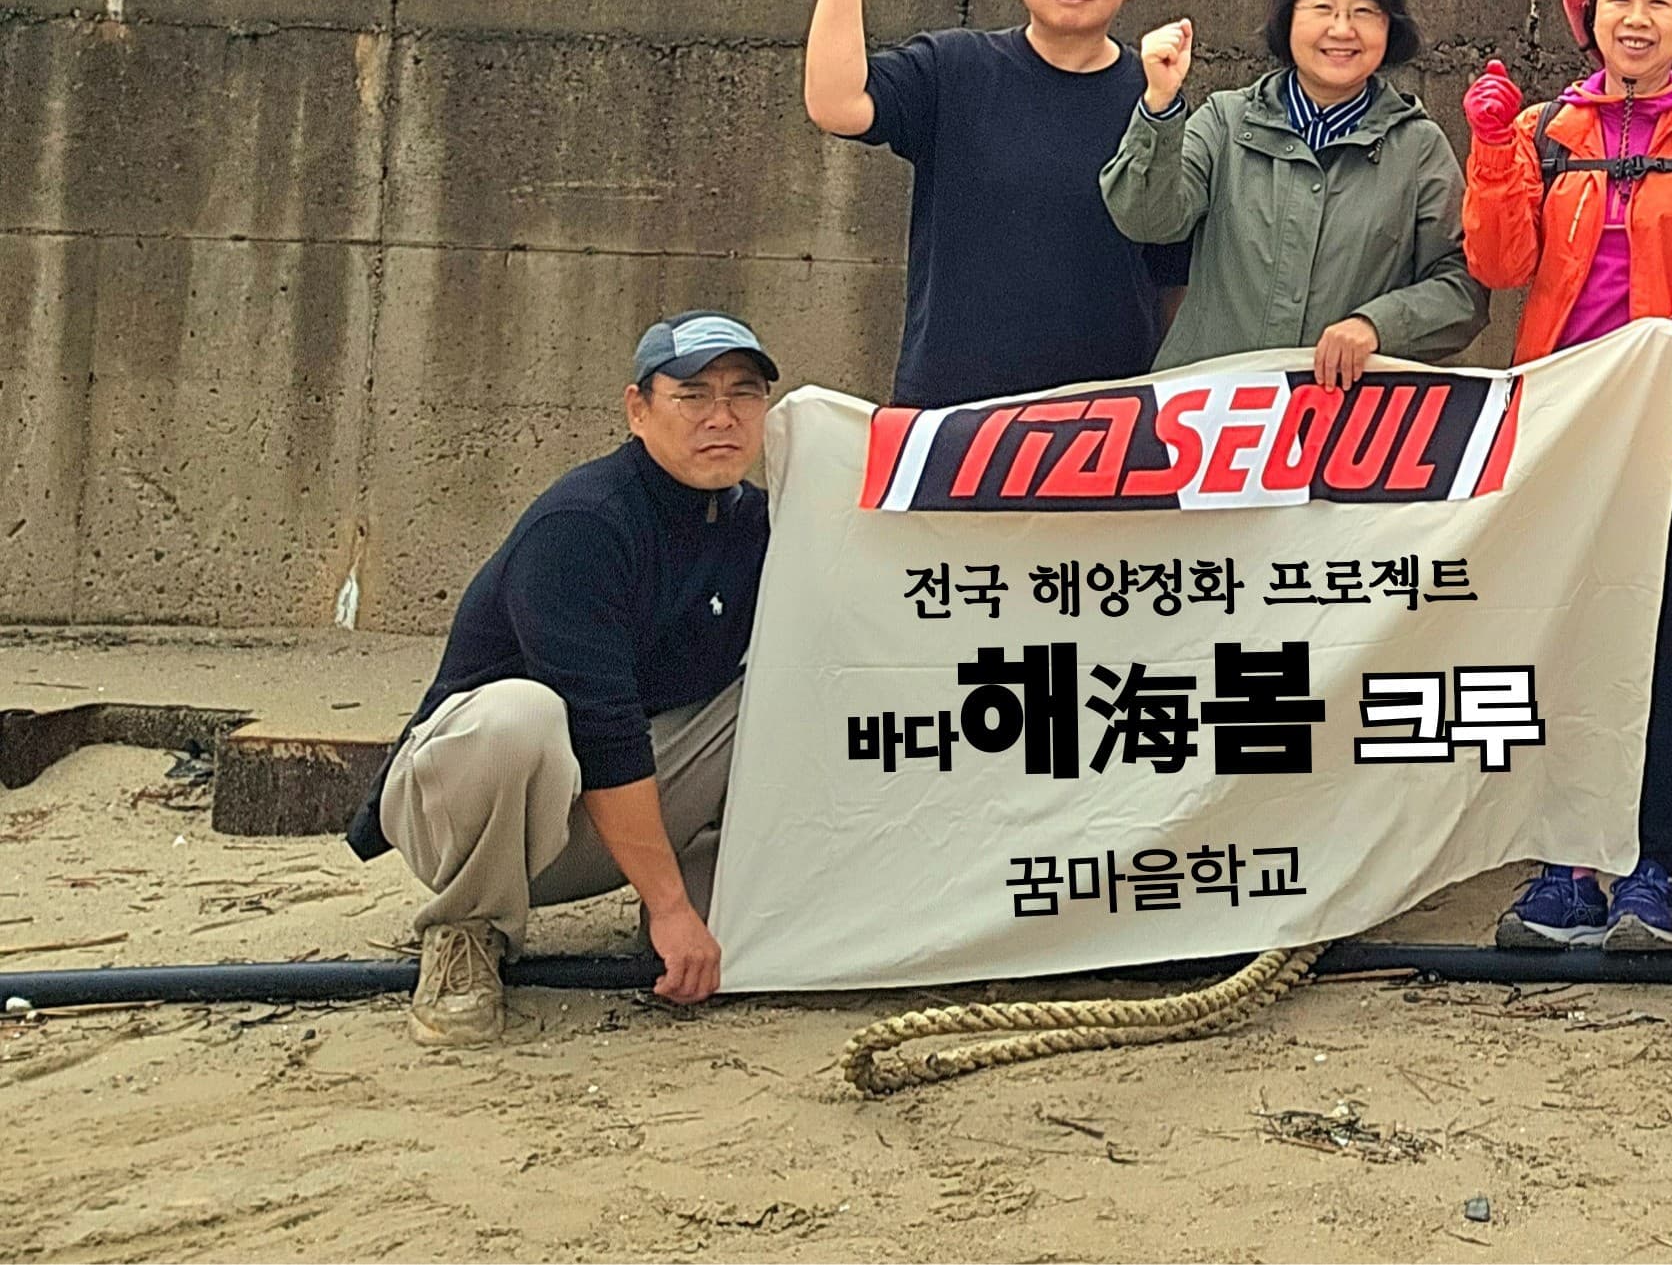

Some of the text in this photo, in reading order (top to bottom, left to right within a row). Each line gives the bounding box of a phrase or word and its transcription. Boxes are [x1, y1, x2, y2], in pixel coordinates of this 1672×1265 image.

[903, 554, 1479, 620] 전국 해양정화 프로젝트
[1353, 664, 1547, 773] 크루
[1005, 843, 1307, 918] 꿈마을학교
